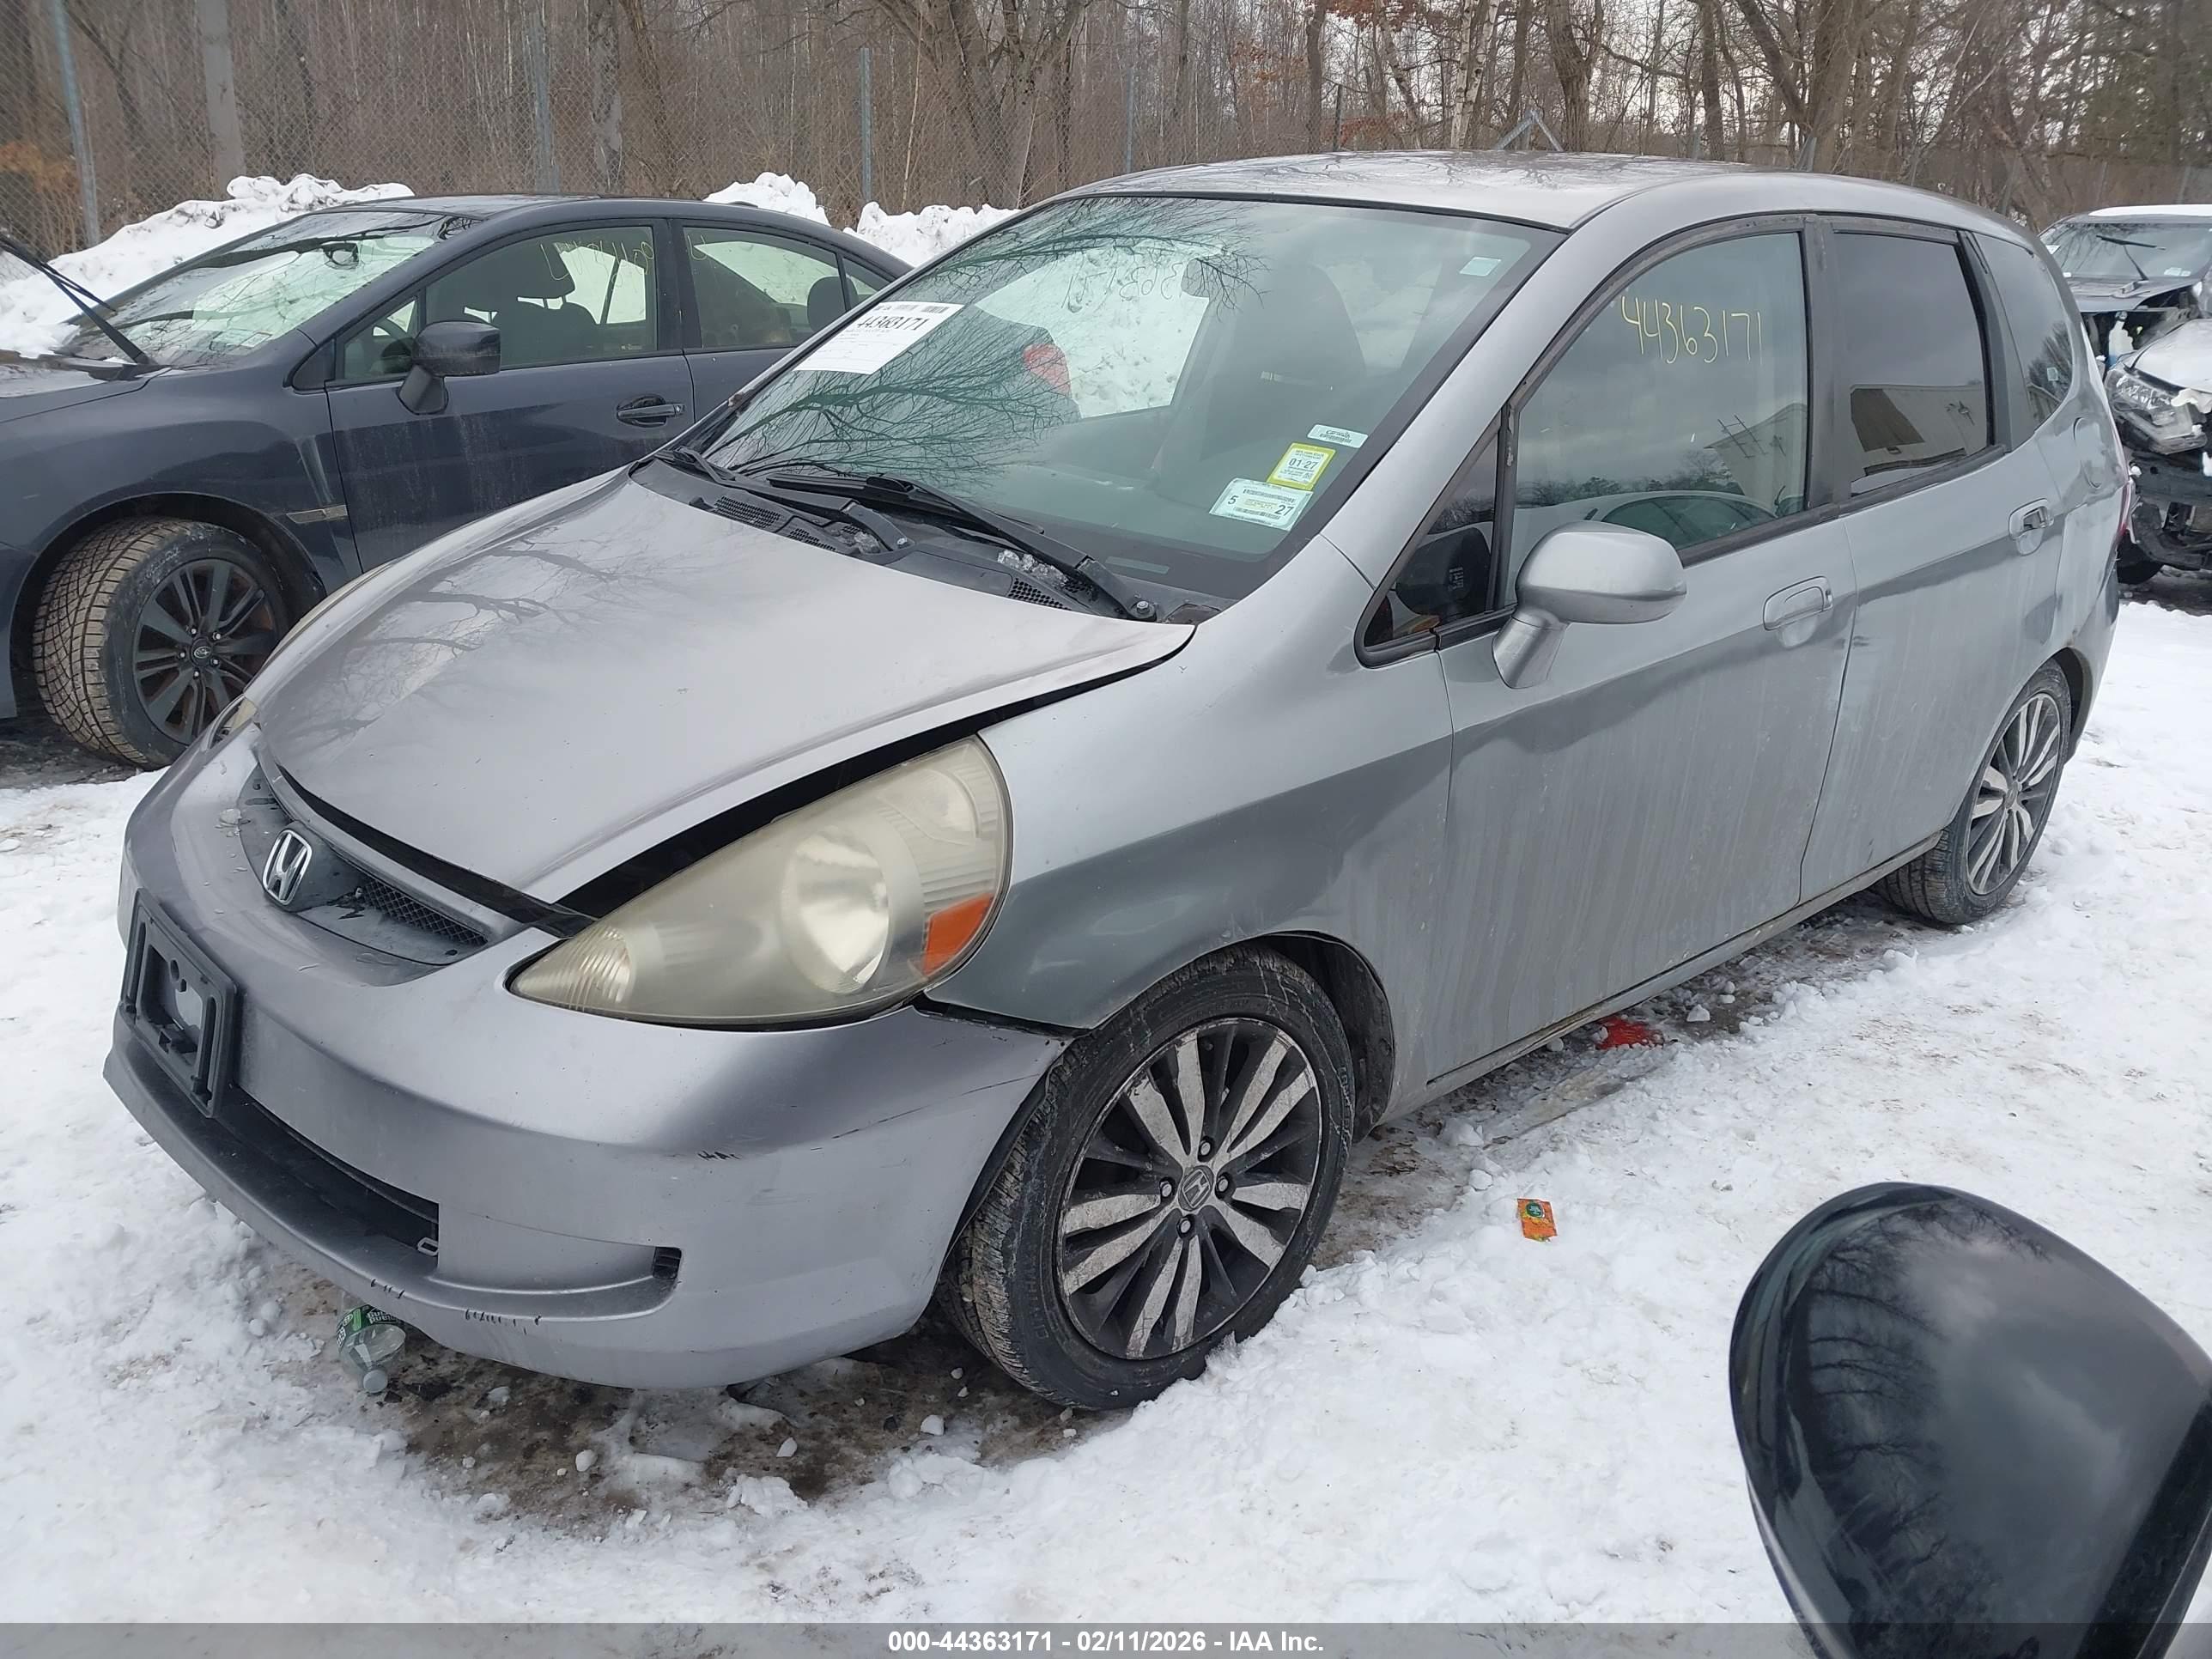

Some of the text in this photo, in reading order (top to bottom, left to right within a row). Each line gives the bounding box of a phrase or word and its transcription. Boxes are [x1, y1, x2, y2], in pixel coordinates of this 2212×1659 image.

[1620, 295, 1762, 364] 44363171
[1227, 495, 1239, 505] 5
[1274, 504, 1295, 517] 27
